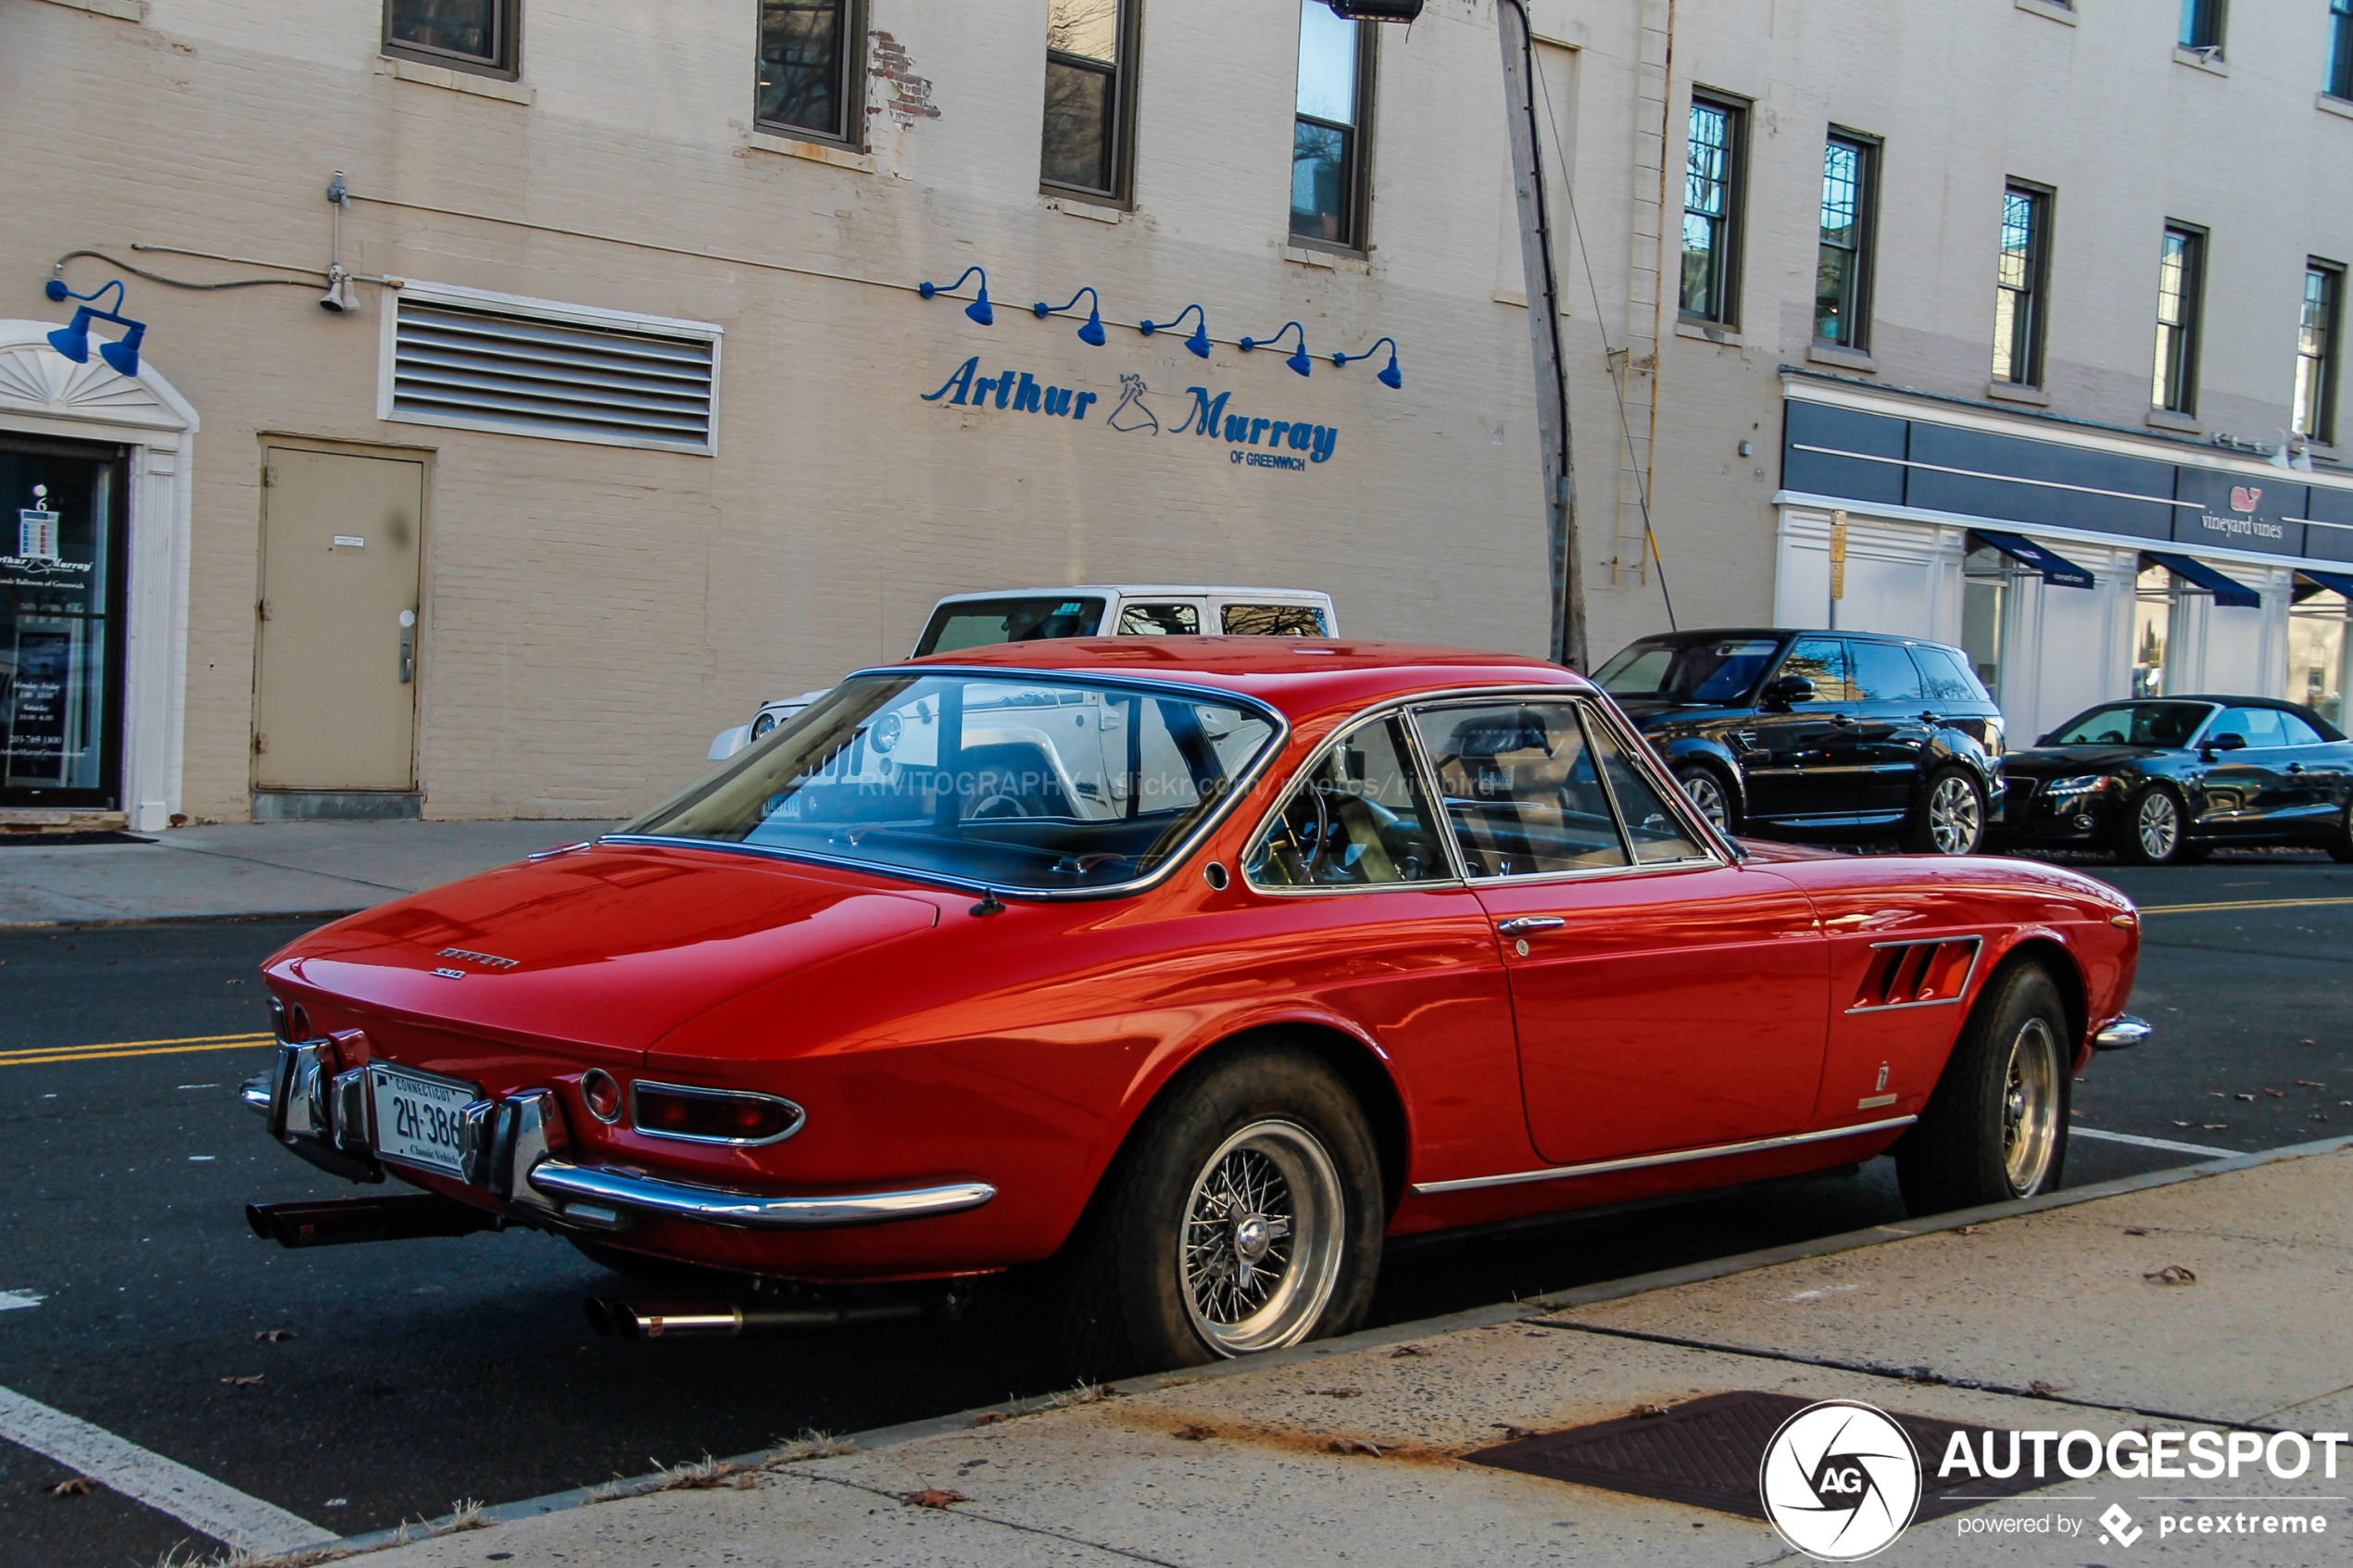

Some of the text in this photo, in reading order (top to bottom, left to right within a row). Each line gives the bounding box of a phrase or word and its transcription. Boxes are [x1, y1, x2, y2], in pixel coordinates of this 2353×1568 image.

[920, 356, 1339, 463] Arthur Murray
[1230, 449, 1305, 472] OF GREENWICH
[35, 496, 47, 512] 6
[2201, 510, 2284, 539] vineyard vines
[396, 1078, 451, 1103] CONNECTICUT
[409, 1144, 434, 1160] Classic
